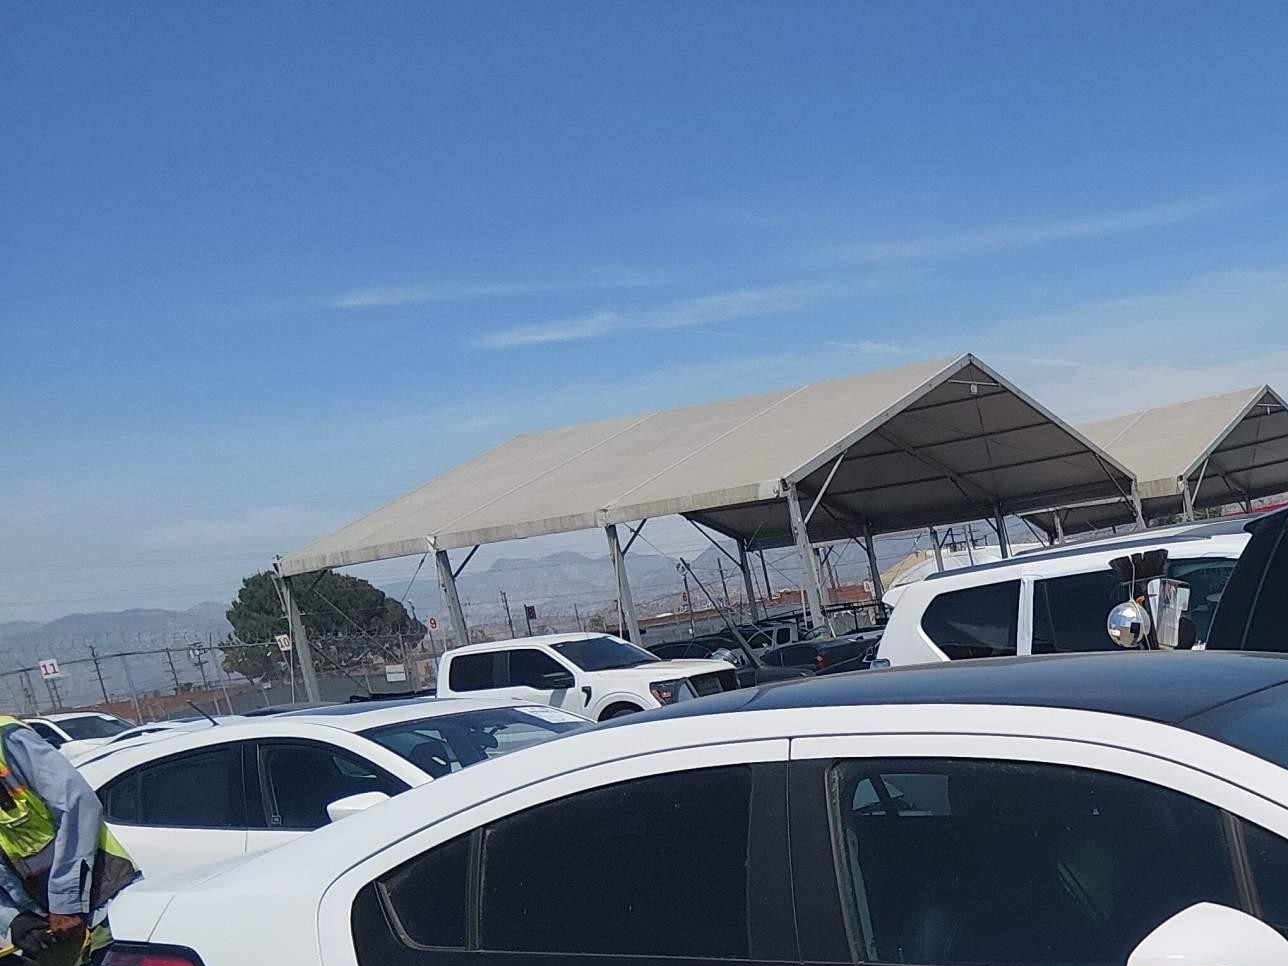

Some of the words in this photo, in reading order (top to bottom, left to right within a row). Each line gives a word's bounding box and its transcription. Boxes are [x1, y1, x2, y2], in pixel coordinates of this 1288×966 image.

[430, 617, 437, 629] 9
[278, 637, 290, 648] 10
[42, 663, 58, 675] 11
